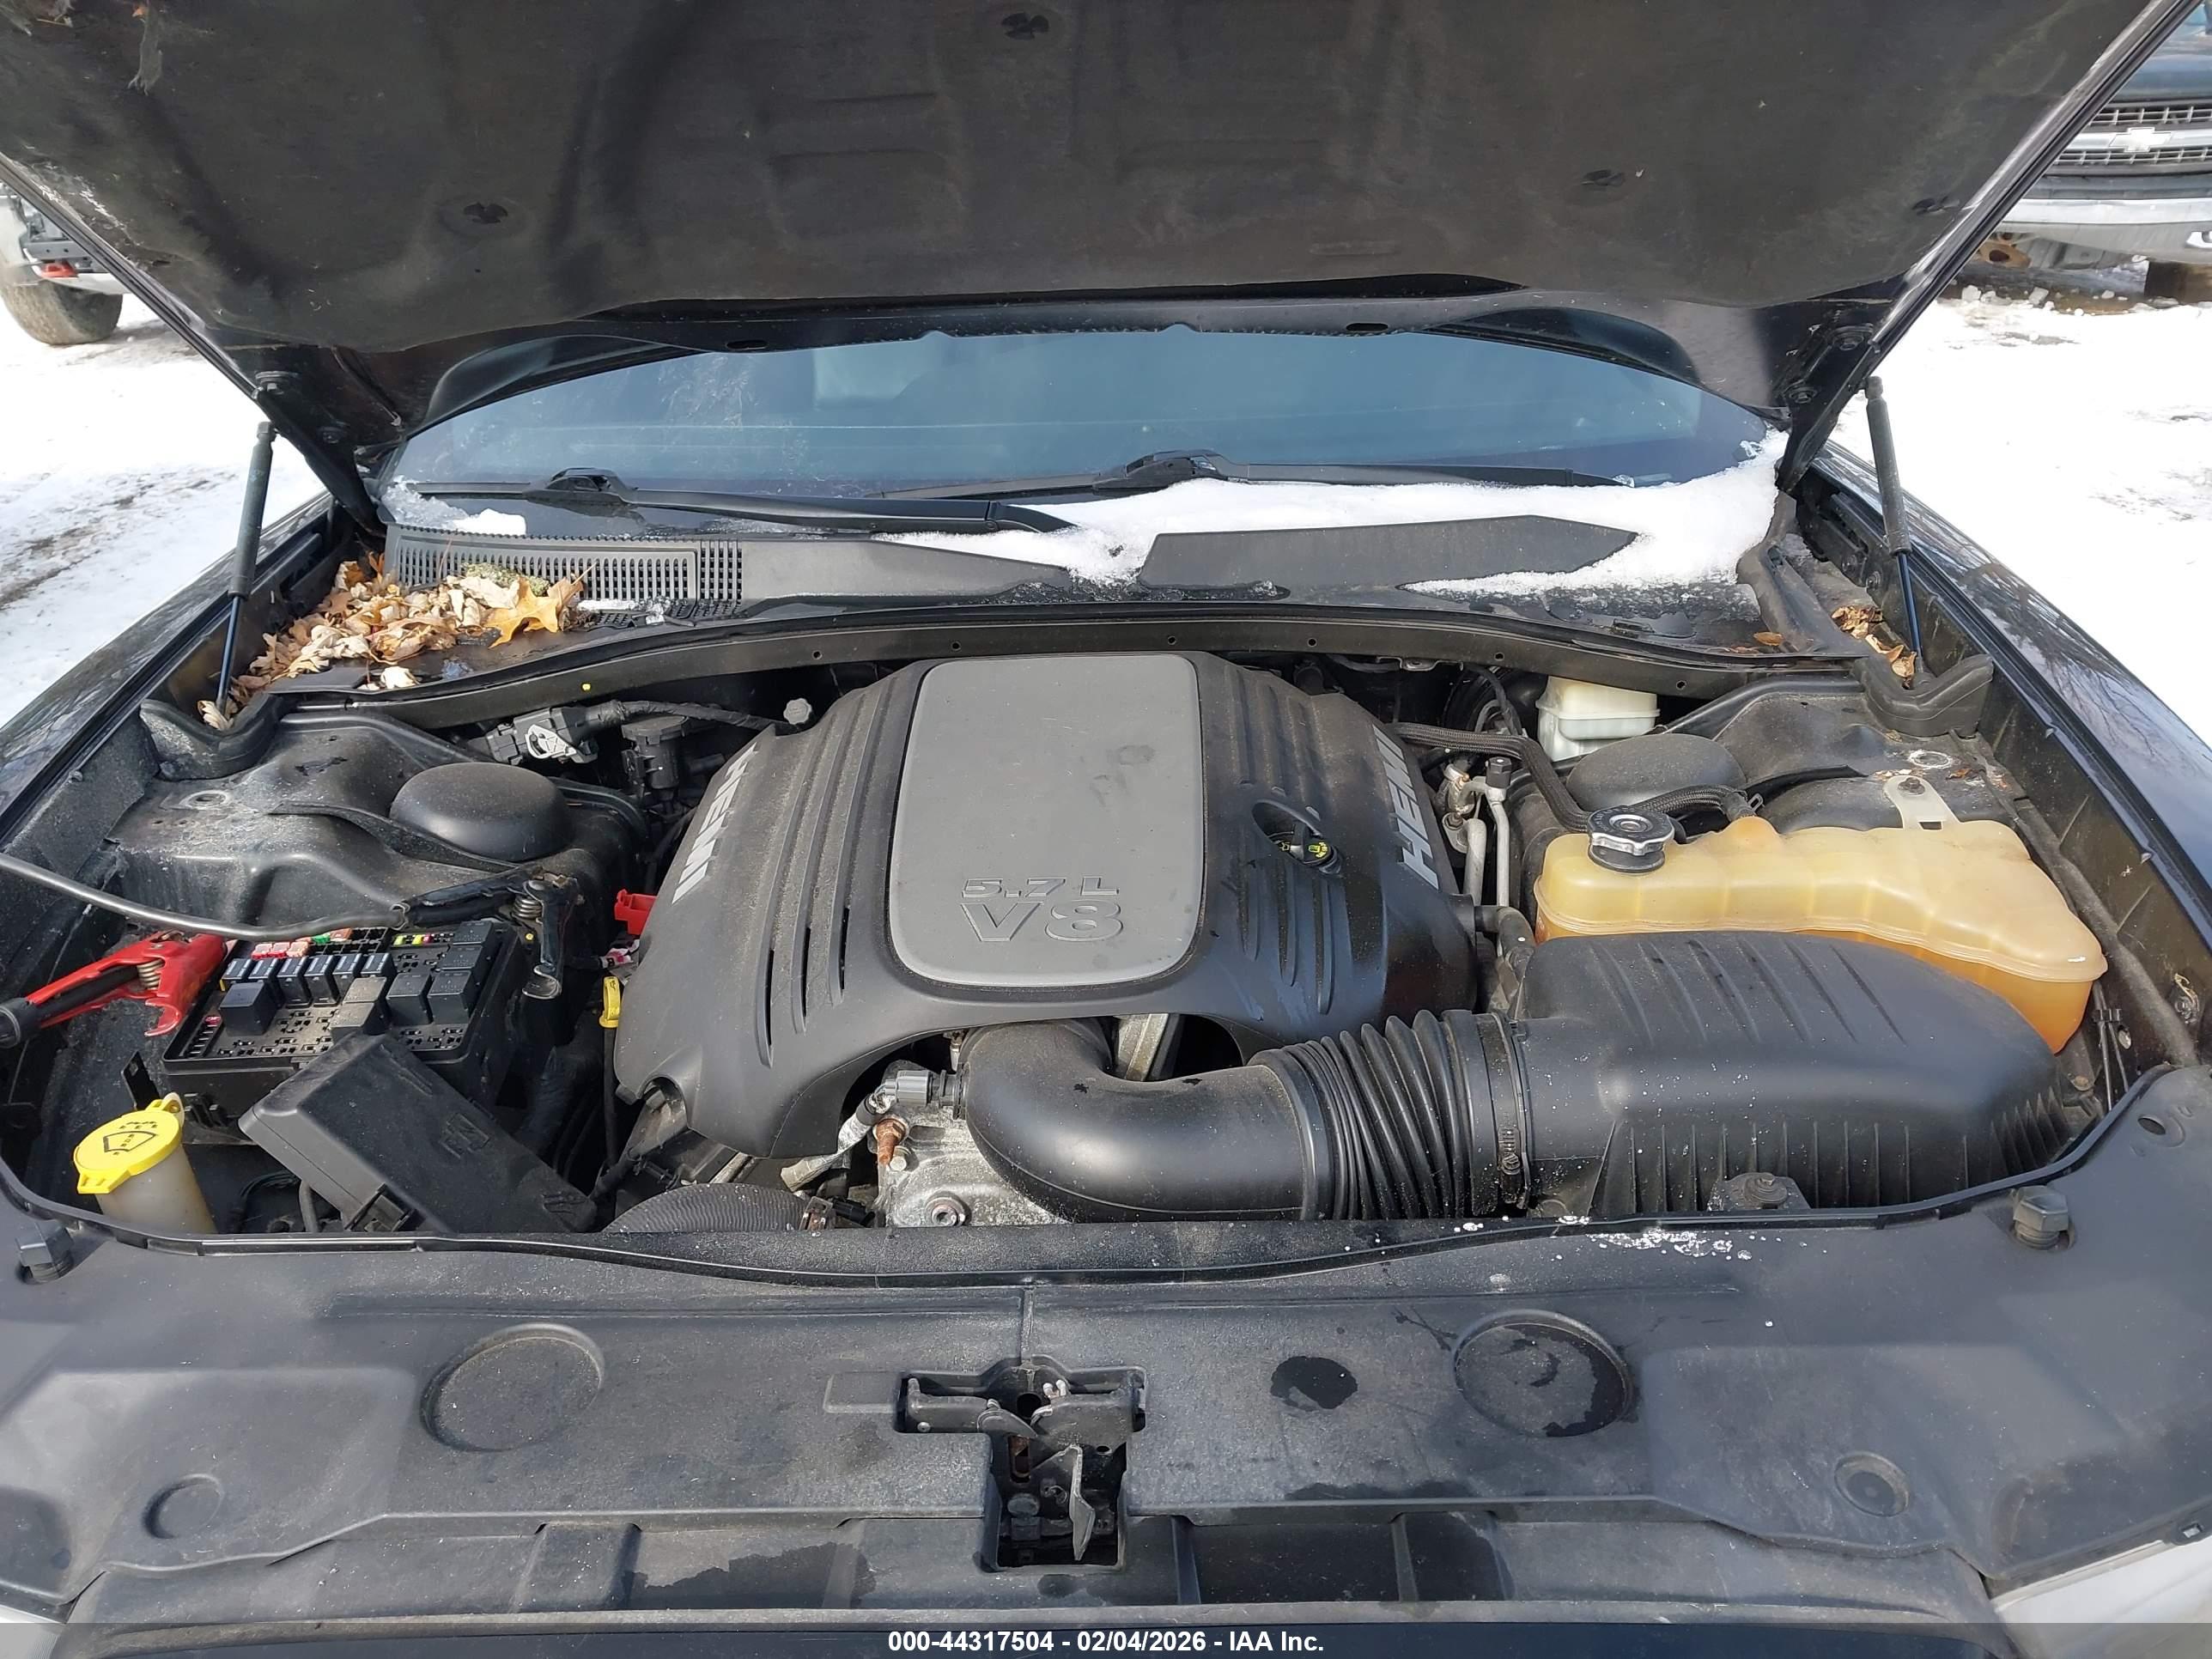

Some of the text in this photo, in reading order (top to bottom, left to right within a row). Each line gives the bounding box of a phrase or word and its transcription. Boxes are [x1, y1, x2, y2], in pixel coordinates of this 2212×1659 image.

[672, 741, 757, 904] HEMI
[1372, 724, 1439, 890] HEMI
[960, 899, 1124, 942] V8
